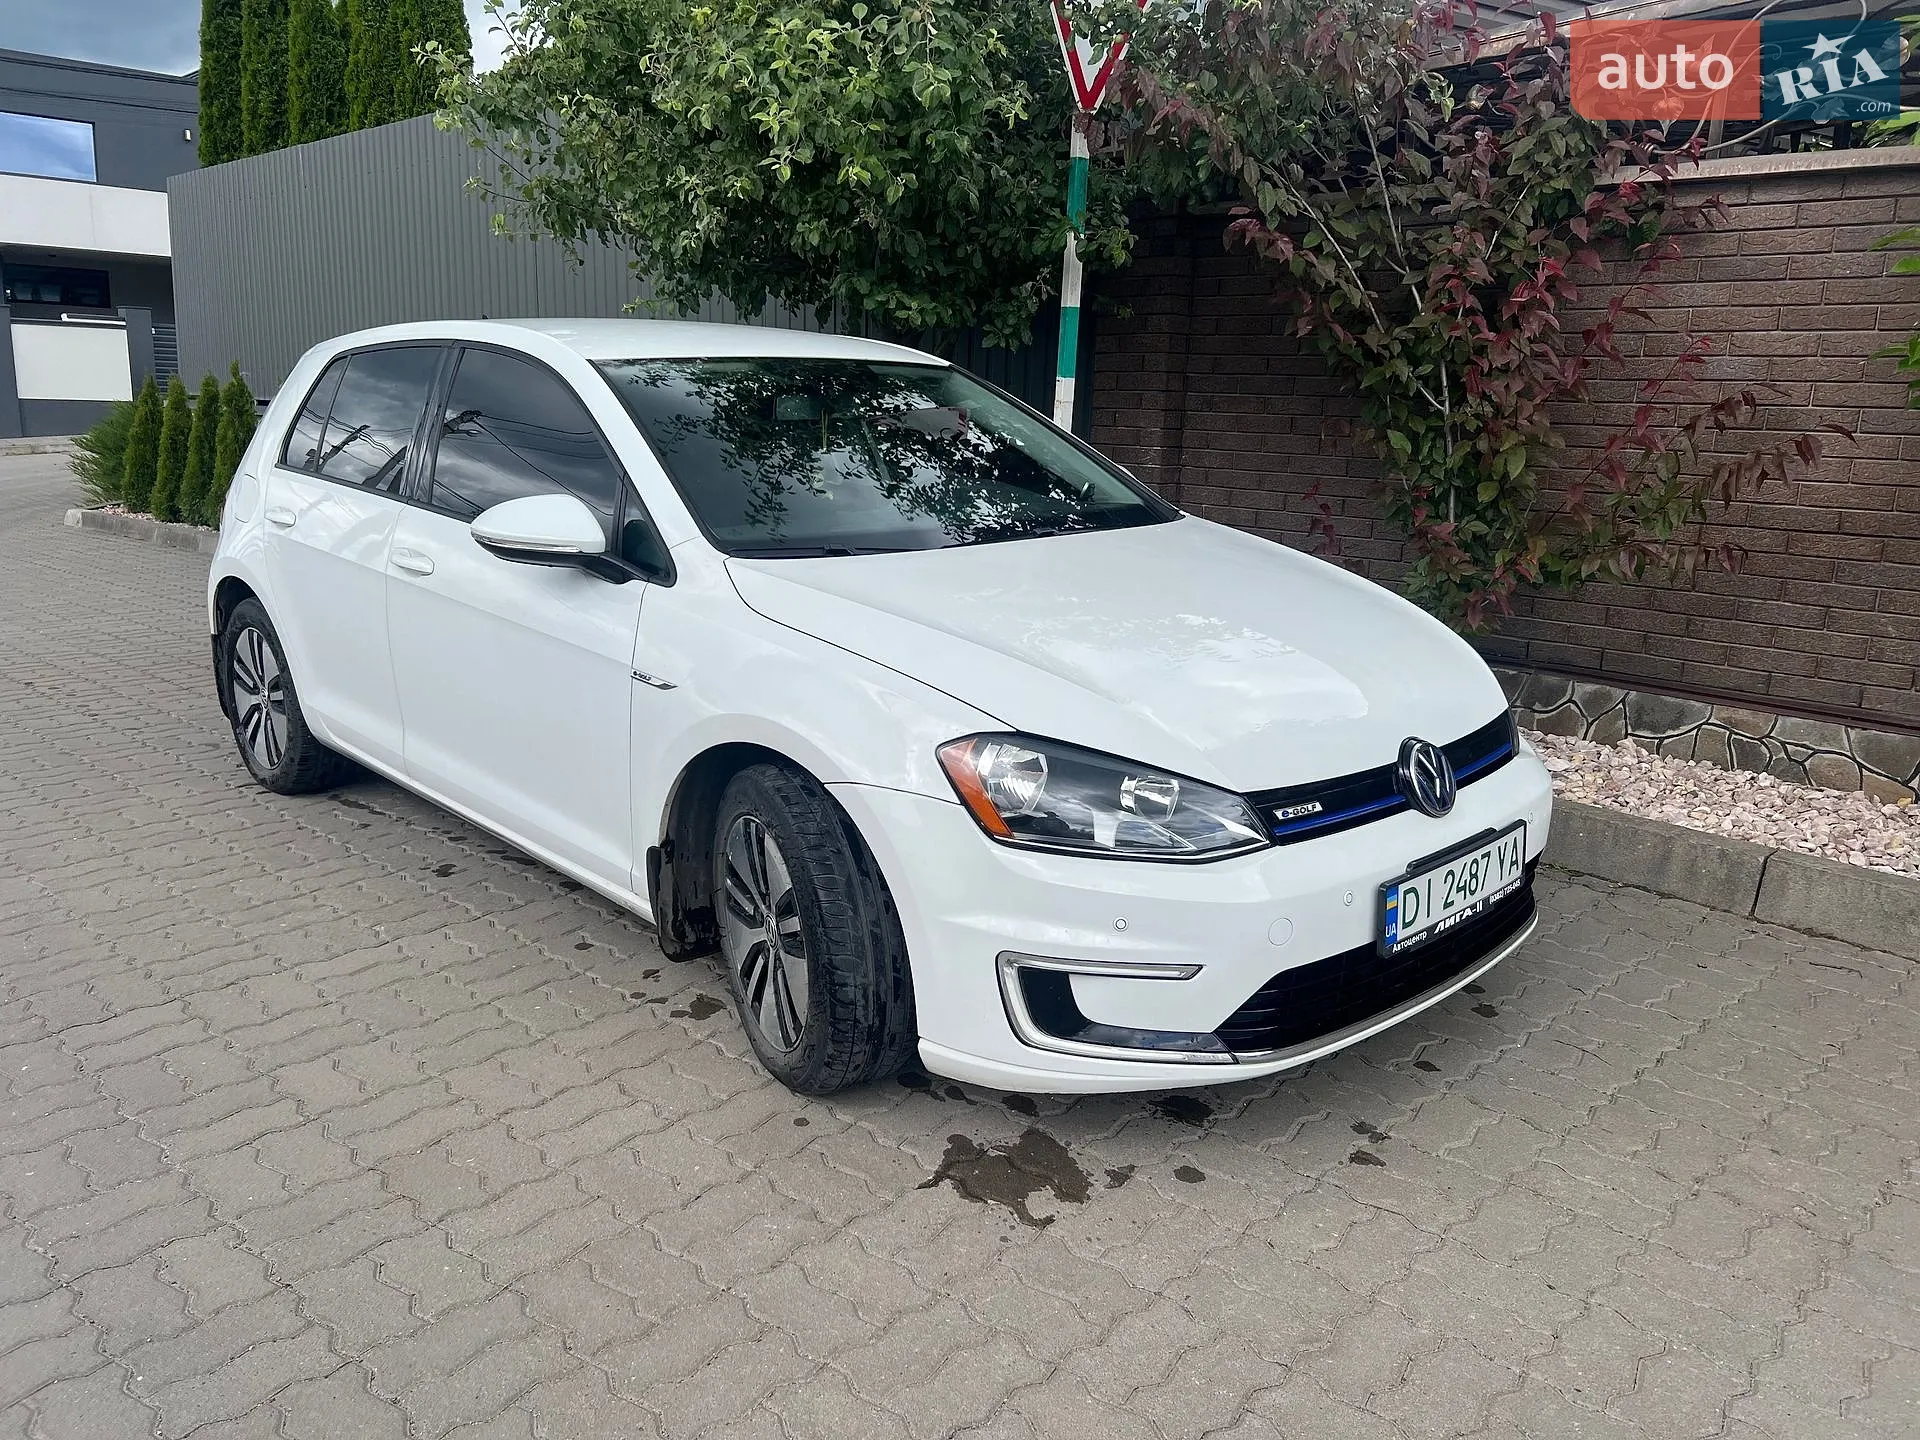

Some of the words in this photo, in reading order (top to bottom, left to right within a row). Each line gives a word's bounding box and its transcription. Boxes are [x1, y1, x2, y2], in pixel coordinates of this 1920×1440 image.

[1281, 803, 1317, 818] e-GOLF
[1401, 879, 1432, 930] DI
[1442, 850, 1492, 910] 2487
[1498, 836, 1519, 881] YA
[1385, 924, 1397, 938] UA
[1392, 931, 1427, 953] Автоцентр
